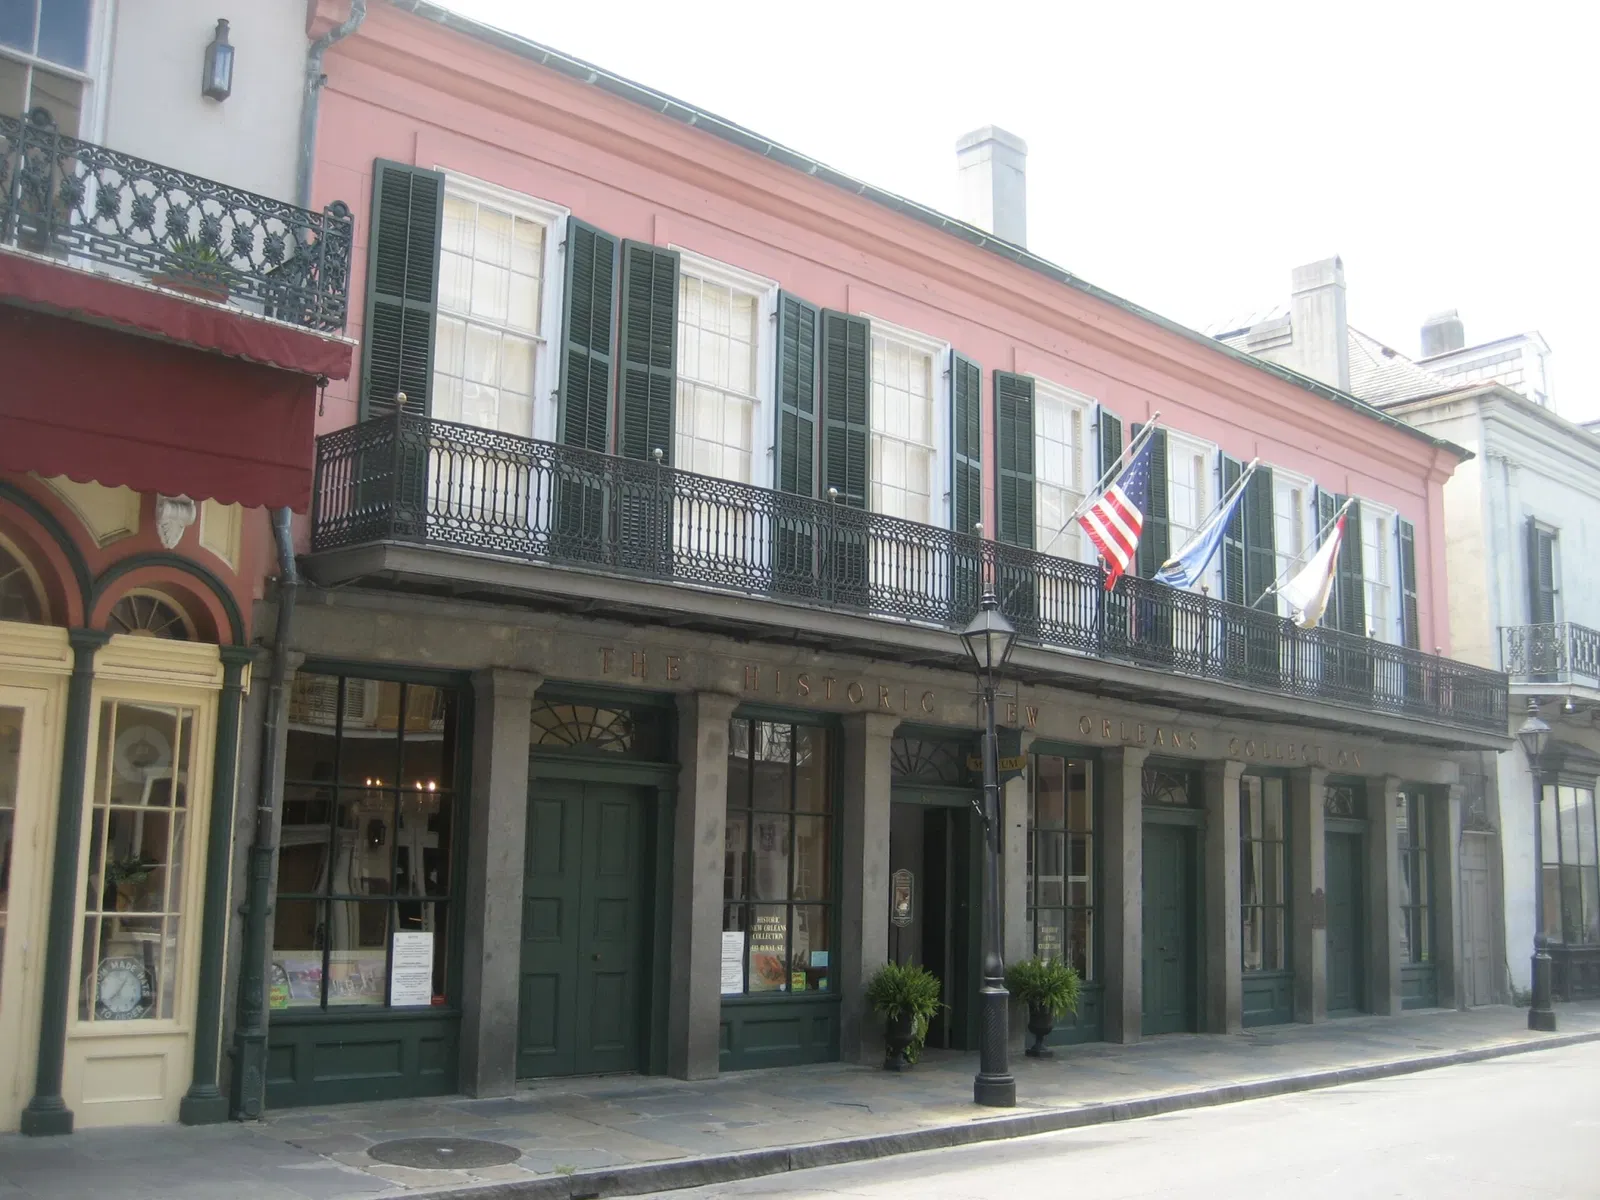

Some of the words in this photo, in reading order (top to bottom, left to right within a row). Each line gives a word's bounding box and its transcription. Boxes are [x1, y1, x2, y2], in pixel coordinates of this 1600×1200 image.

[599, 646, 682, 681] THE
[744, 665, 936, 713] HISTORIC
[1078, 714, 1198, 751] ORLEANS
[1228, 735, 1360, 769] COLLECTION
[973, 758, 1018, 769] MUM
[763, 924, 787, 932] ORLEANS
[752, 932, 784, 940] COLLECTION
[110, 960, 137, 973] MADE
[137, 971, 150, 996] HATS
[100, 1008, 112, 1019] TO
[115, 1004, 144, 1019] ORDER
